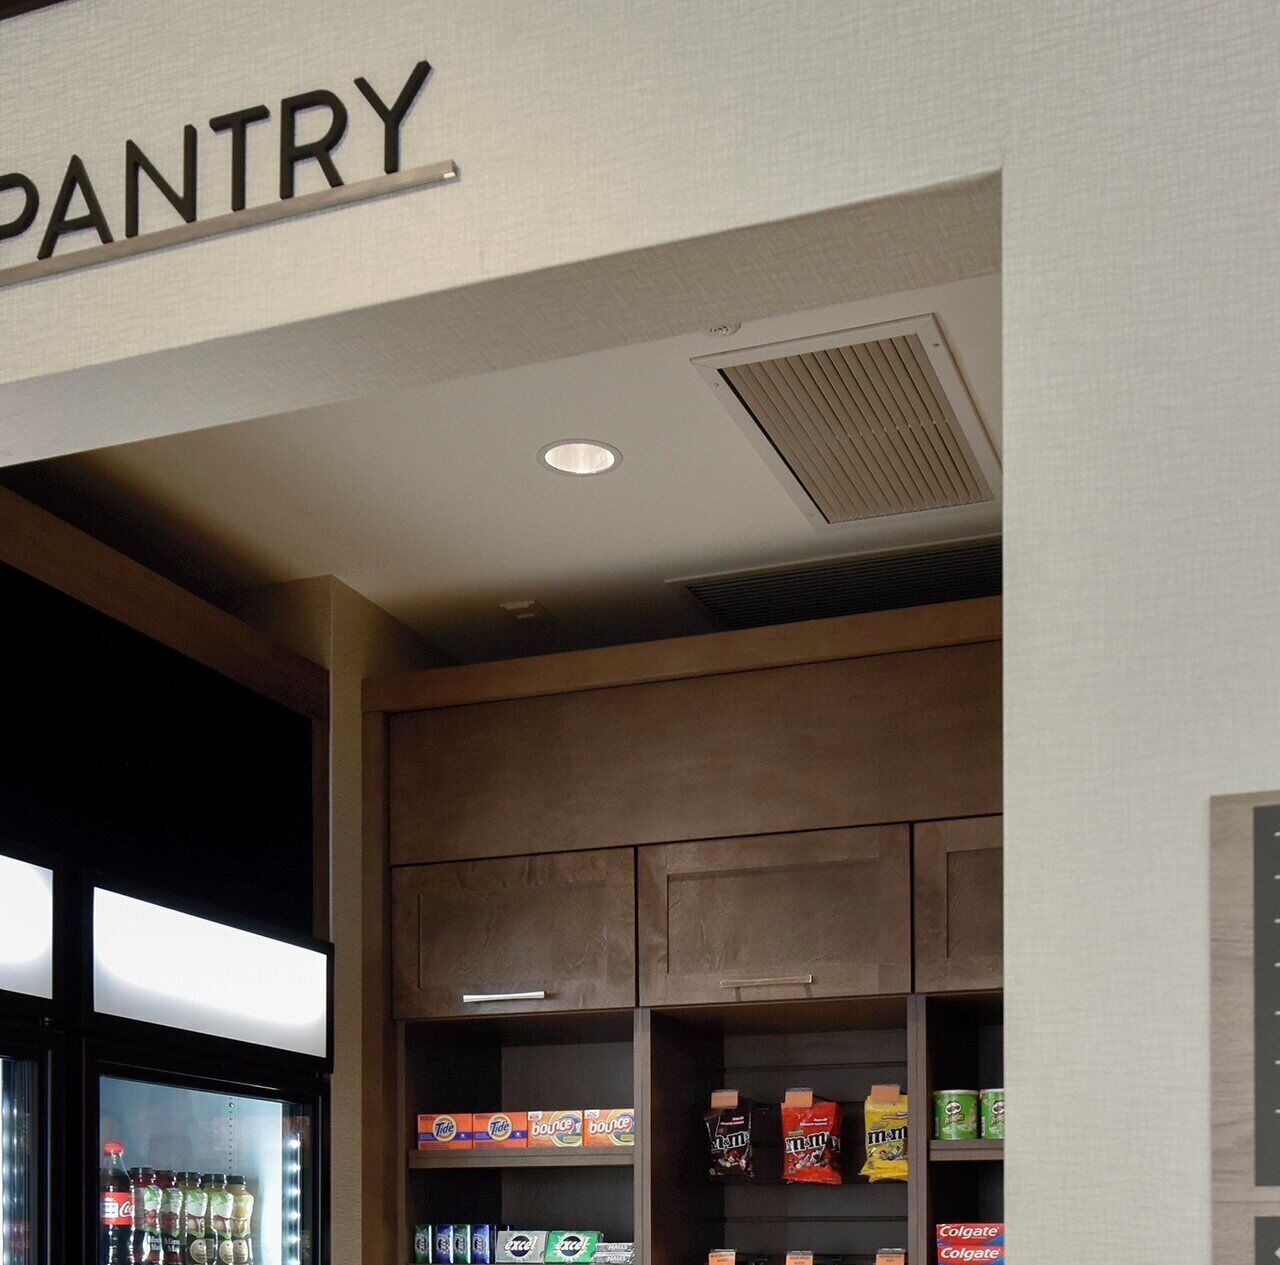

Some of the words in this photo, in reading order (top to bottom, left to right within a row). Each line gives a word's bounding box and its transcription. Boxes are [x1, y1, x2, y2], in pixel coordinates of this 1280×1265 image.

[435, 1121, 455, 1137] Tide
[490, 1120, 510, 1136] Tide
[532, 1118, 573, 1136] bounce
[589, 1117, 631, 1135] bounce
[940, 1225, 998, 1239] Colgate
[504, 1236, 537, 1251] excel
[555, 1236, 587, 1251] excel
[941, 1247, 1000, 1261] Colgate
